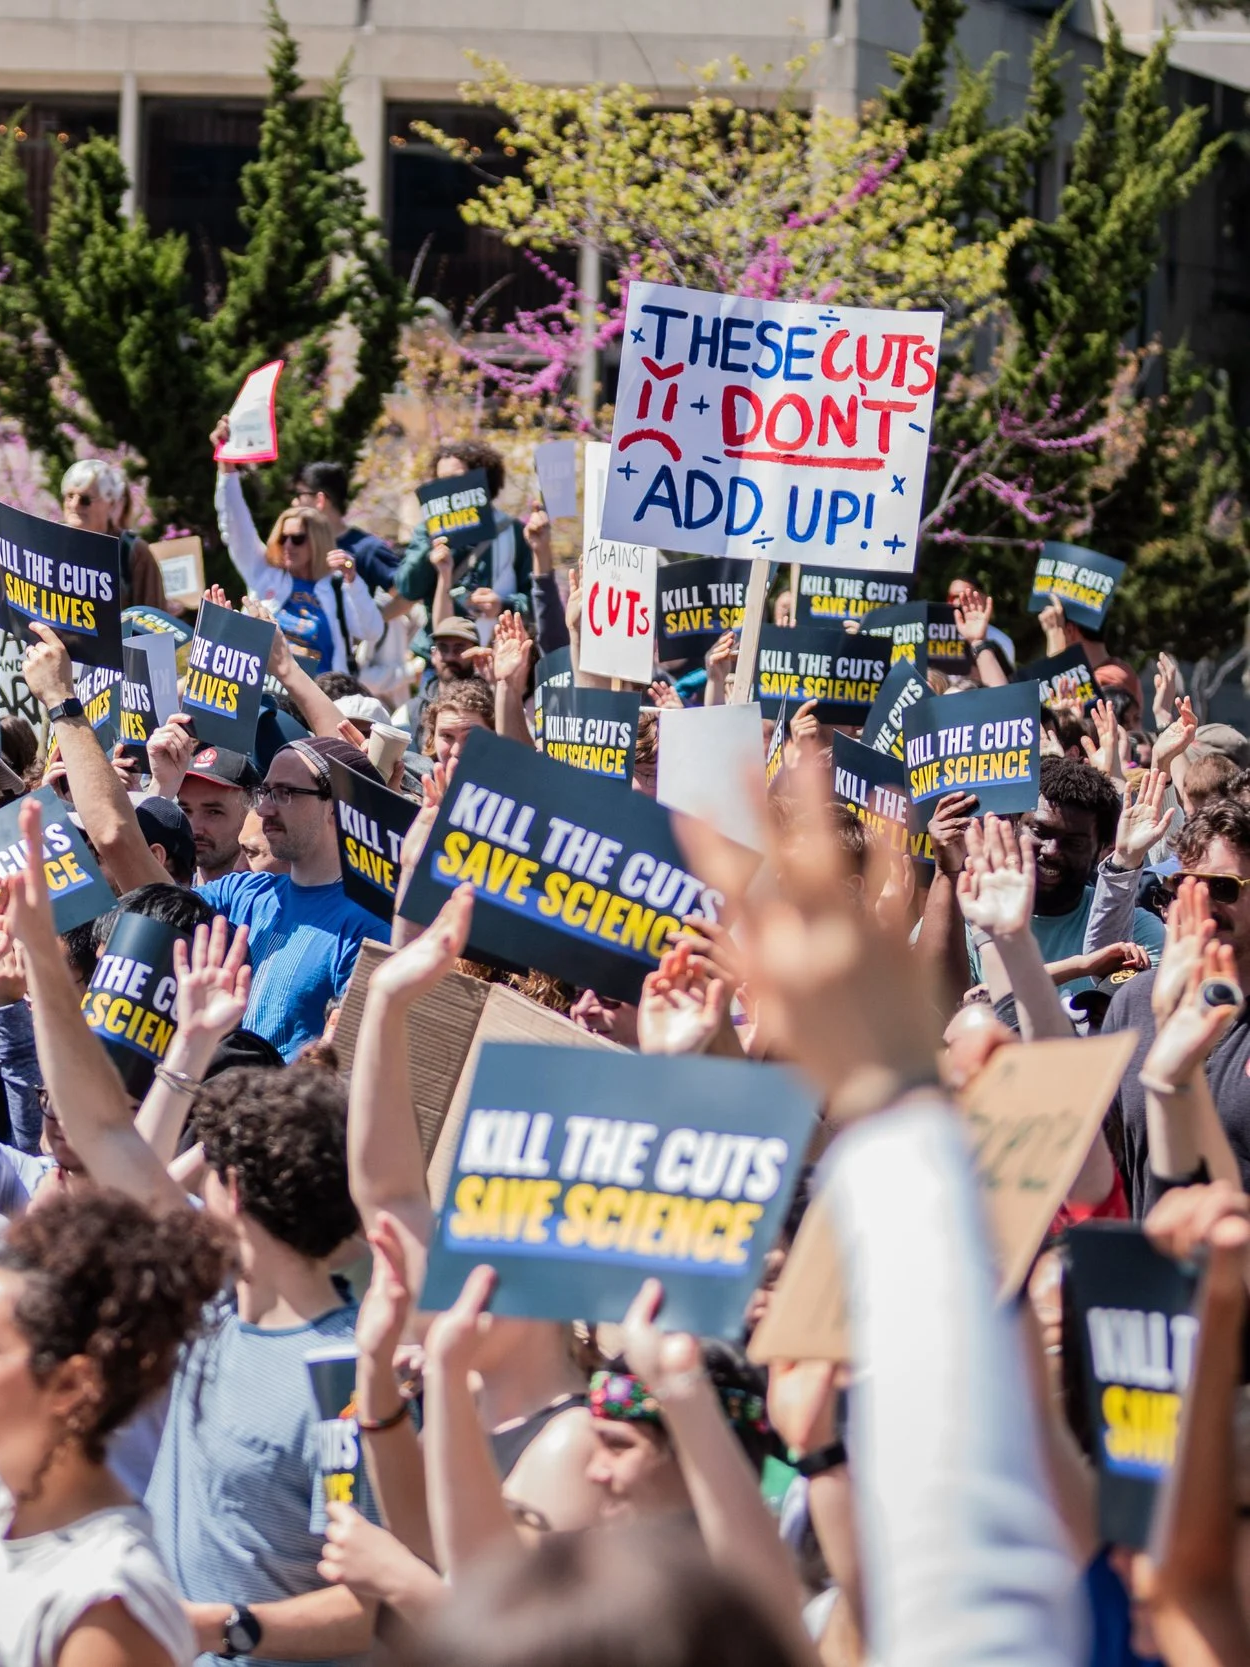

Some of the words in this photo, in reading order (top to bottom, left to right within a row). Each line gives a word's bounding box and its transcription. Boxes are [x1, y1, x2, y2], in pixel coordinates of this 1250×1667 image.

[641, 305, 817, 381] THESE
[821, 329, 936, 396] CUTS
[721, 382, 918, 455] DON'T
[450, 487, 487, 511] CUTS
[633, 464, 763, 536] ADD
[786, 485, 876, 550] UP!
[24, 549, 53, 587] THE
[59, 562, 113, 601] CUTS
[587, 536, 647, 573] AGAINST
[662, 586, 703, 612] KILL
[708, 583, 743, 605] THE
[801, 575, 832, 596] KILL
[835, 578, 864, 598] THE
[866, 582, 908, 603] CUTS
[1054, 579, 1106, 608] SCIENCE
[1055, 560, 1078, 580] THE
[1077, 567, 1114, 595] CUTS
[5, 573, 37, 613] SAVE
[41, 589, 96, 630] LIVES
[665, 609, 712, 634] SAVE
[810, 596, 846, 617] SAVE
[893, 622, 925, 644] CUTS
[928, 641, 965, 658] ENCE
[212, 645, 261, 686] CUTS
[759, 650, 795, 674] KILL
[798, 653, 833, 677] THE
[836, 657, 885, 681] CUTS
[122, 680, 150, 712] CUTS
[190, 674, 240, 713] LIVES
[759, 672, 800, 697] SAVE
[803, 677, 881, 702] SCIENCE
[546, 716, 564, 740] KILL
[565, 717, 583, 742] THE
[584, 719, 631, 748] CUTS
[906, 733, 934, 769] KILL
[938, 725, 974, 757] THE
[980, 717, 1034, 750] CUTS
[568, 744, 627, 775] SCIENCE
[910, 761, 941, 799] SAVE
[943, 749, 1031, 786] SCIENCE
[835, 766, 869, 807] KILL
[874, 785, 906, 824] THE
[339, 800, 384, 853] KILL
[891, 823, 935, 859] LIVE
[345, 837, 395, 893] SAVE
[448, 781, 537, 854] KILL
[541, 817, 623, 885] THE
[619, 852, 725, 924] CUTS
[437, 831, 540, 905] SAVE
[537, 871, 700, 960] SCIENC
[93, 955, 152, 1000] THE
[87, 994, 174, 1057] SCIEN
[457, 1108, 553, 1177] KILL
[559, 1115, 658, 1188] THE
[654, 1127, 789, 1201] CUTS
[450, 1174, 562, 1244] SAVE
[556, 1182, 764, 1266] SCIENCE
[1086, 1306, 1173, 1390] KILL
